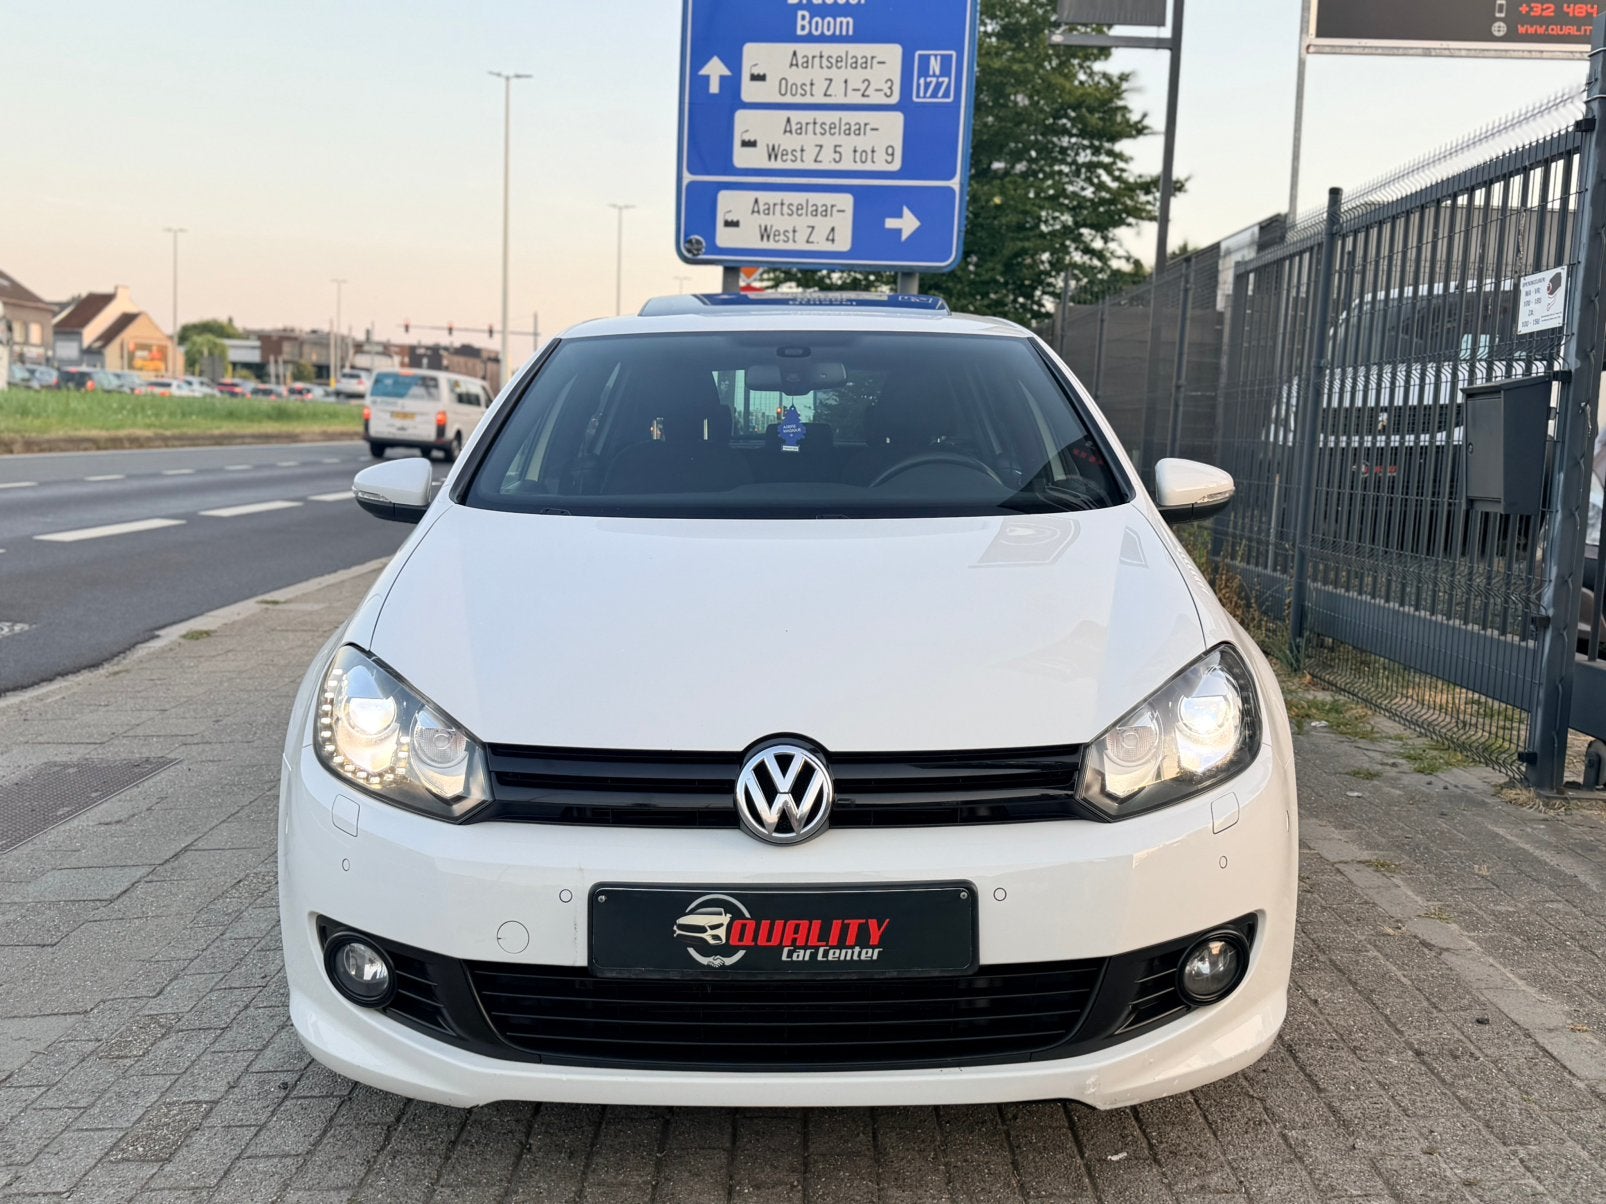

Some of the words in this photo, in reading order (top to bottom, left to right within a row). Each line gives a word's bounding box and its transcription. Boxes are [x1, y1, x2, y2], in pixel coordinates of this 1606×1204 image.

[1519, 3, 1556, 17] +32
[1563, 3, 1599, 18] 484
[796, 10, 854, 36] Boom
[789, 50, 887, 70] Aartselaar-
[929, 55, 942, 76] N
[778, 77, 815, 97] Oost
[918, 77, 949, 98] 177
[783, 116, 880, 136] Aartselaar-
[766, 143, 806, 163] West
[853, 145, 877, 164] tot
[885, 144, 896, 164] 9
[750, 197, 846, 217] Aartselaar-
[758, 224, 798, 244] West
[737, 745, 833, 844] VW
[729, 919, 890, 947] QUALITY
[781, 946, 815, 961] Car
[817, 946, 883, 961] Center
